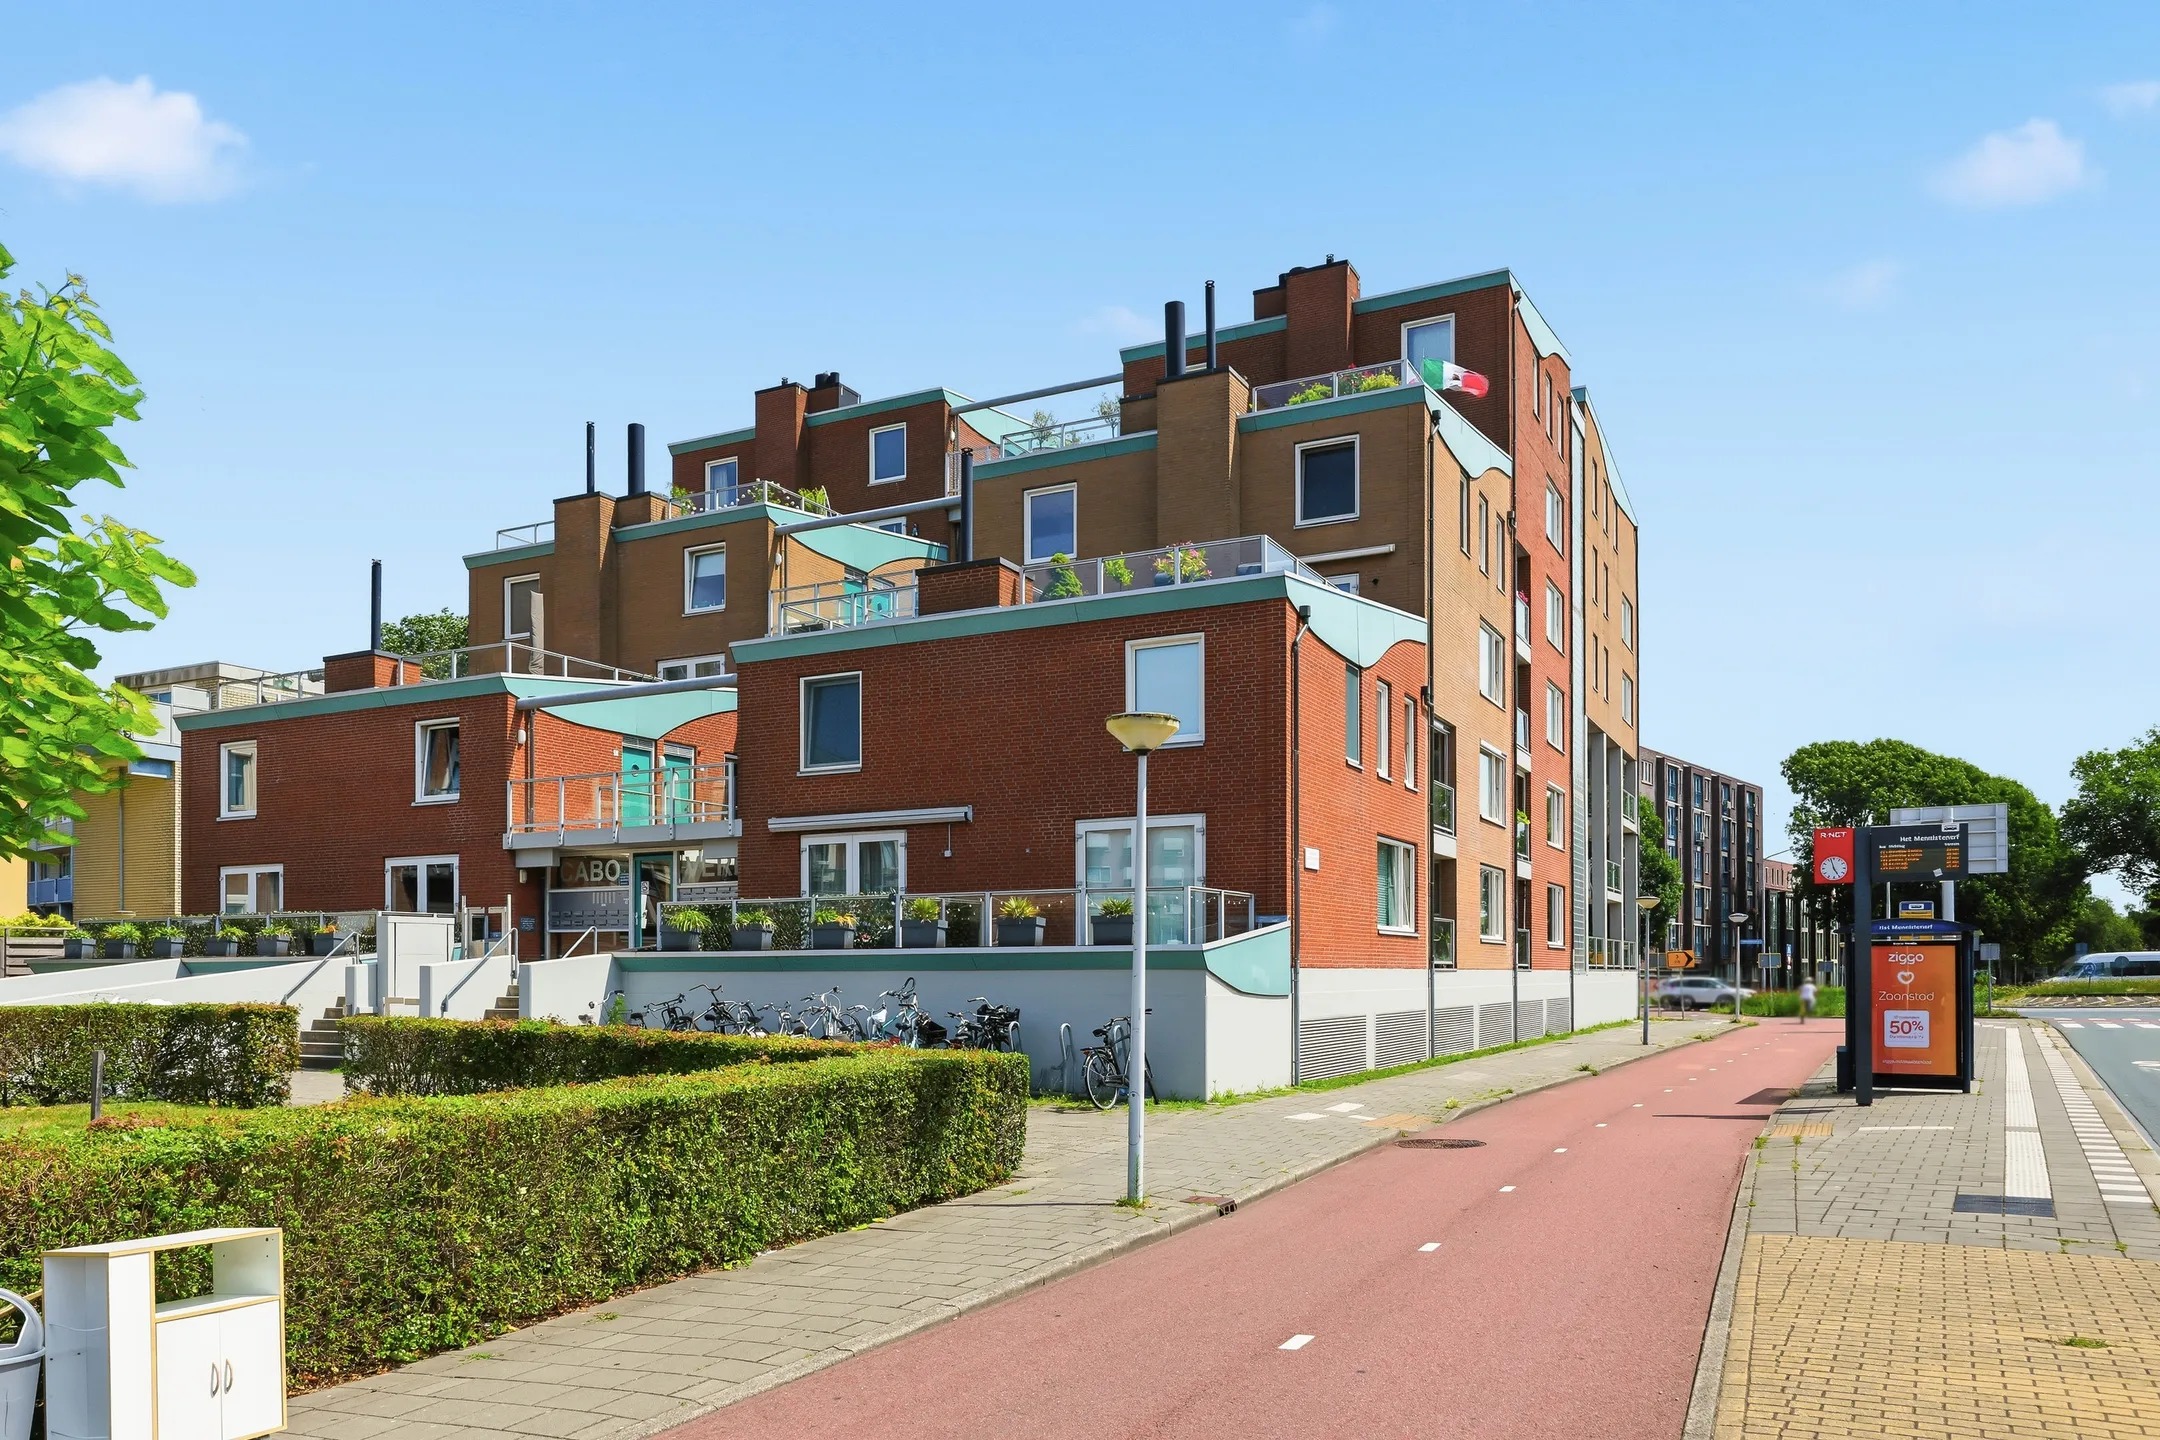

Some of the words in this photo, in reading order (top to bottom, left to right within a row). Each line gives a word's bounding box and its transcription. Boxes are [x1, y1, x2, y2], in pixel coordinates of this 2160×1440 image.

[561, 860, 620, 881] CABO
[1888, 951, 1924, 965] ziggo
[1878, 990, 1935, 1001] Zaanstad
[1890, 1020, 1924, 1035] 50%
